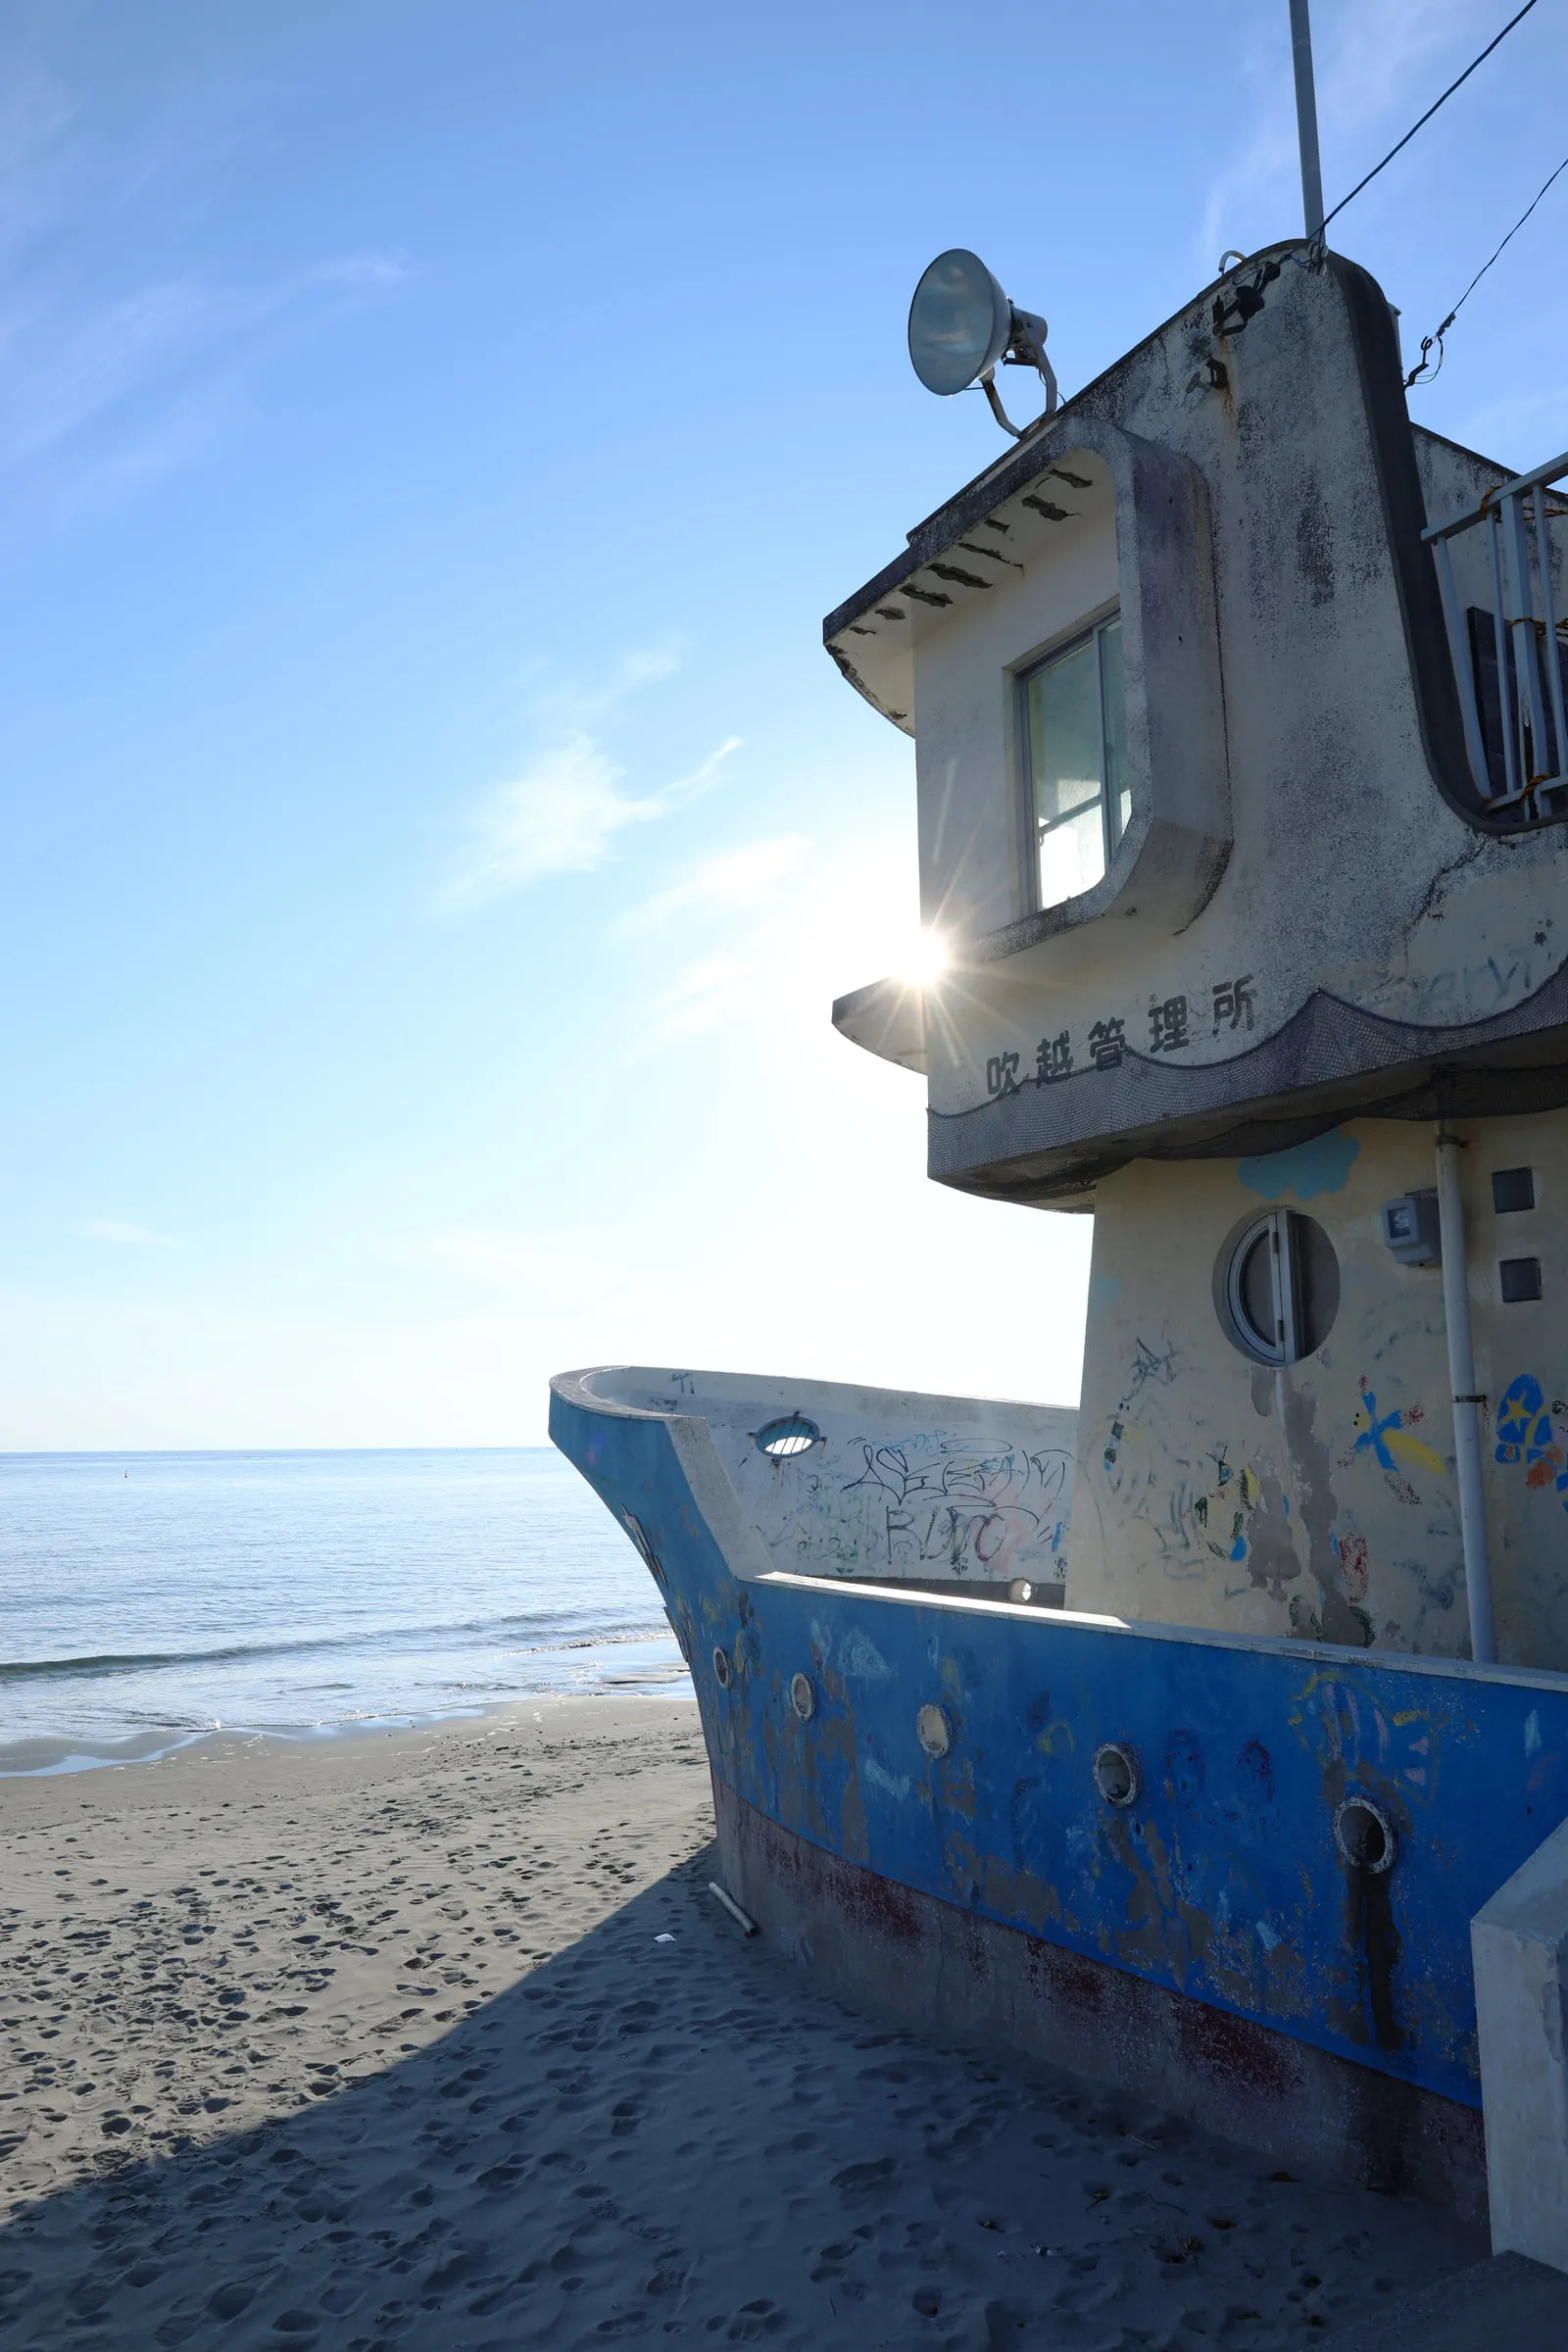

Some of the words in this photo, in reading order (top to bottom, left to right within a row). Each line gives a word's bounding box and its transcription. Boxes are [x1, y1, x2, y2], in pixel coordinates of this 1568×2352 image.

[986, 973, 1256, 1095] 吹越管理所
